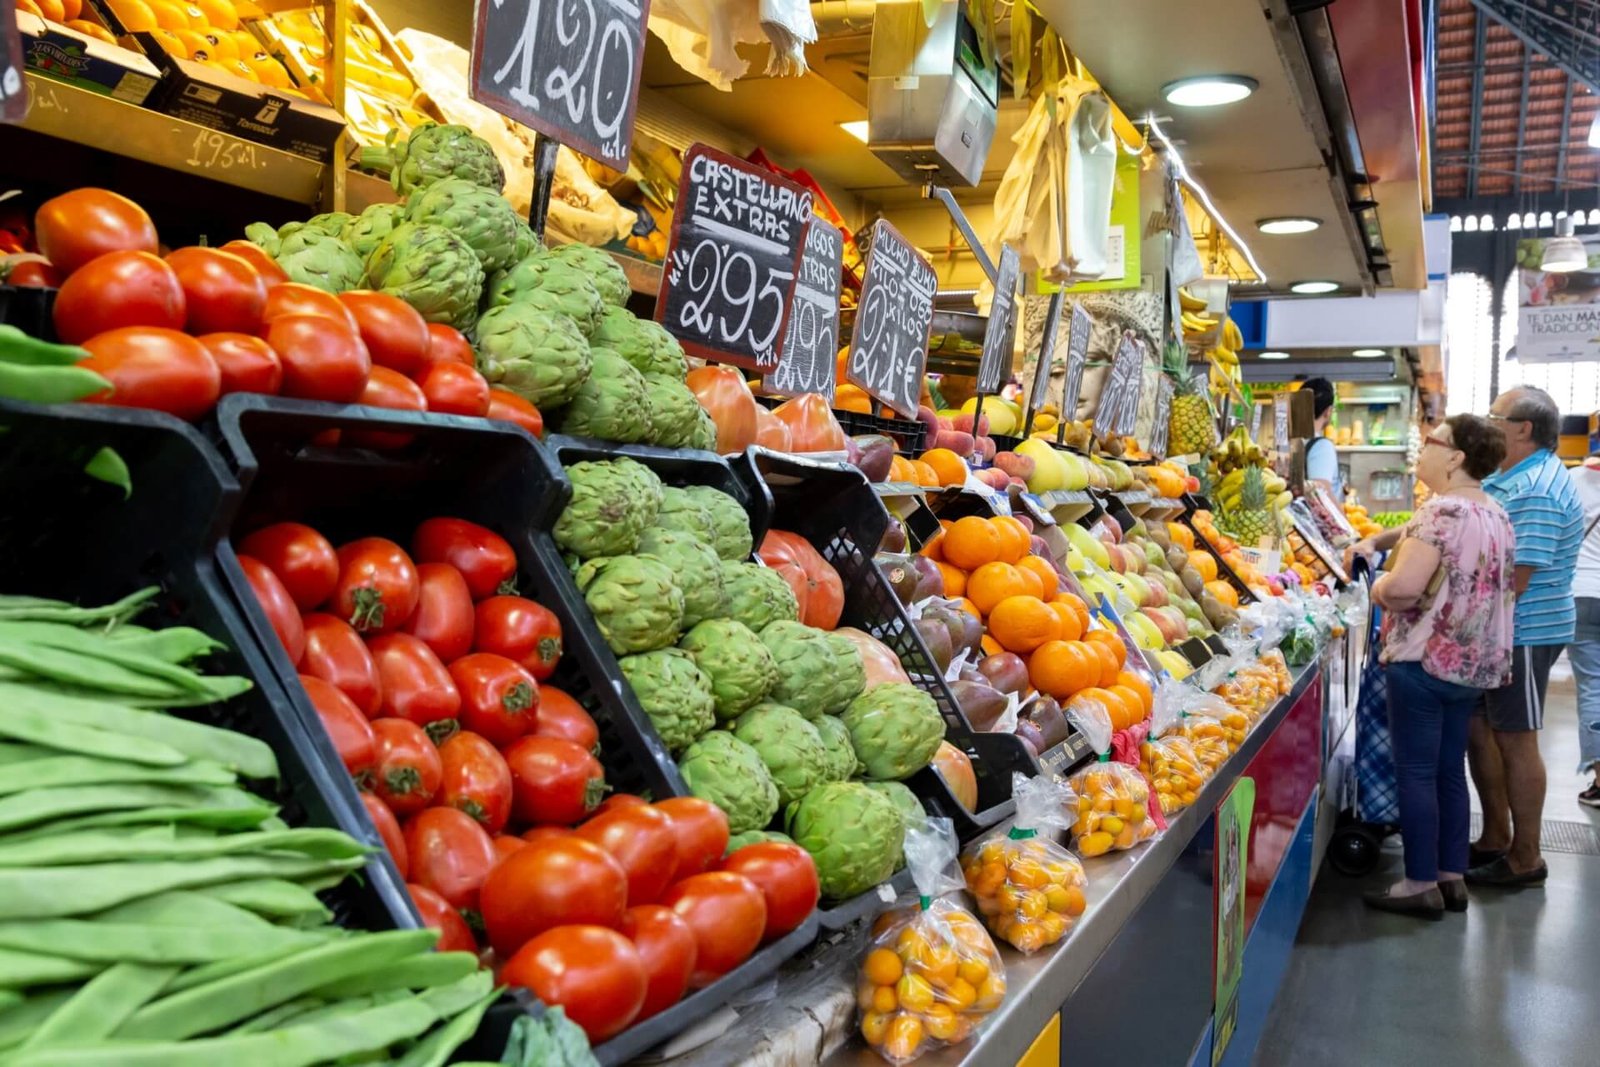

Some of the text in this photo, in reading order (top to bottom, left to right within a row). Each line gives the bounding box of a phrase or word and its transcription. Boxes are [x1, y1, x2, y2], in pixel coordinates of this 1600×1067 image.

[694, 185, 791, 242] EXTRAS
[804, 221, 836, 260] NGOS
[876, 223, 910, 268] MUCHO
[799, 254, 837, 292] TRAS
[870, 260, 898, 298] KILO
[886, 302, 923, 342] KILOS
[1543, 312, 1573, 324] DAN
